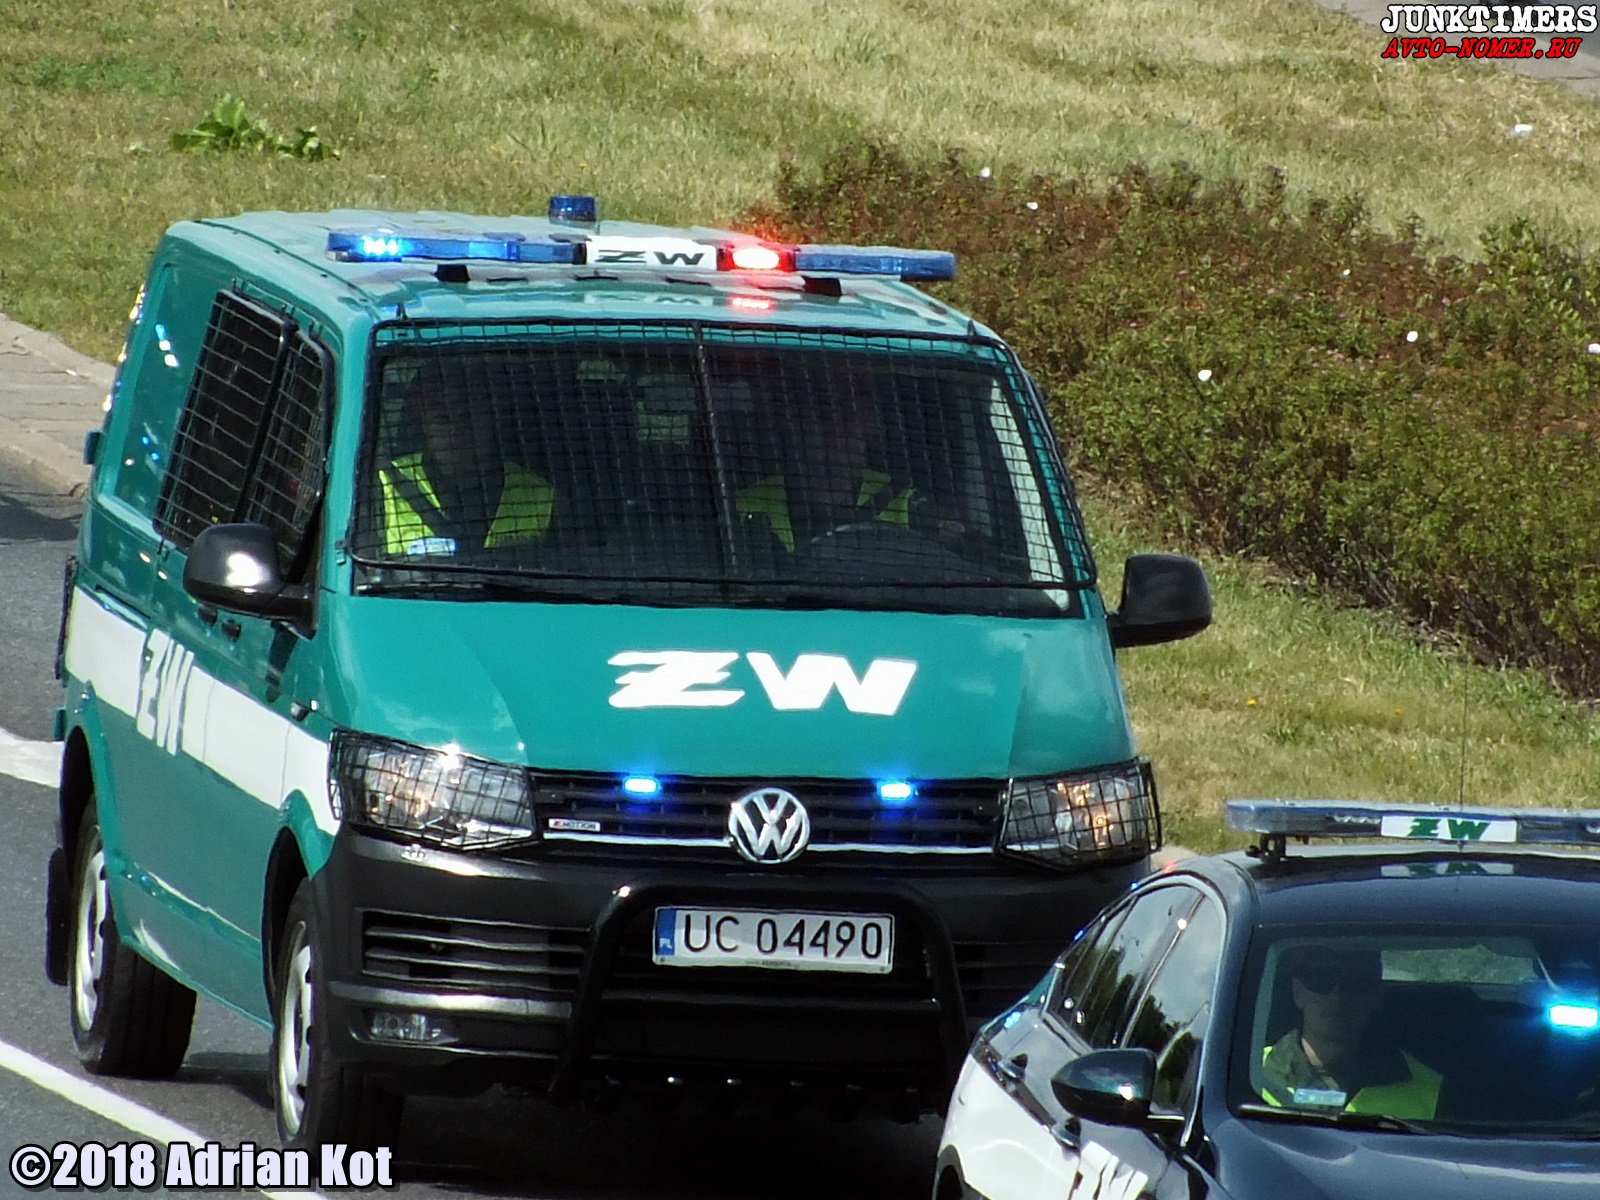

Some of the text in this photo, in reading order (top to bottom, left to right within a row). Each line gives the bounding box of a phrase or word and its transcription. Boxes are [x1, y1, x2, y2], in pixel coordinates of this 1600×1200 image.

[595, 249, 705, 265] ZW
[608, 650, 918, 716] ZW
[1407, 817, 1491, 840] ZW
[683, 913, 883, 960] UC 04490
